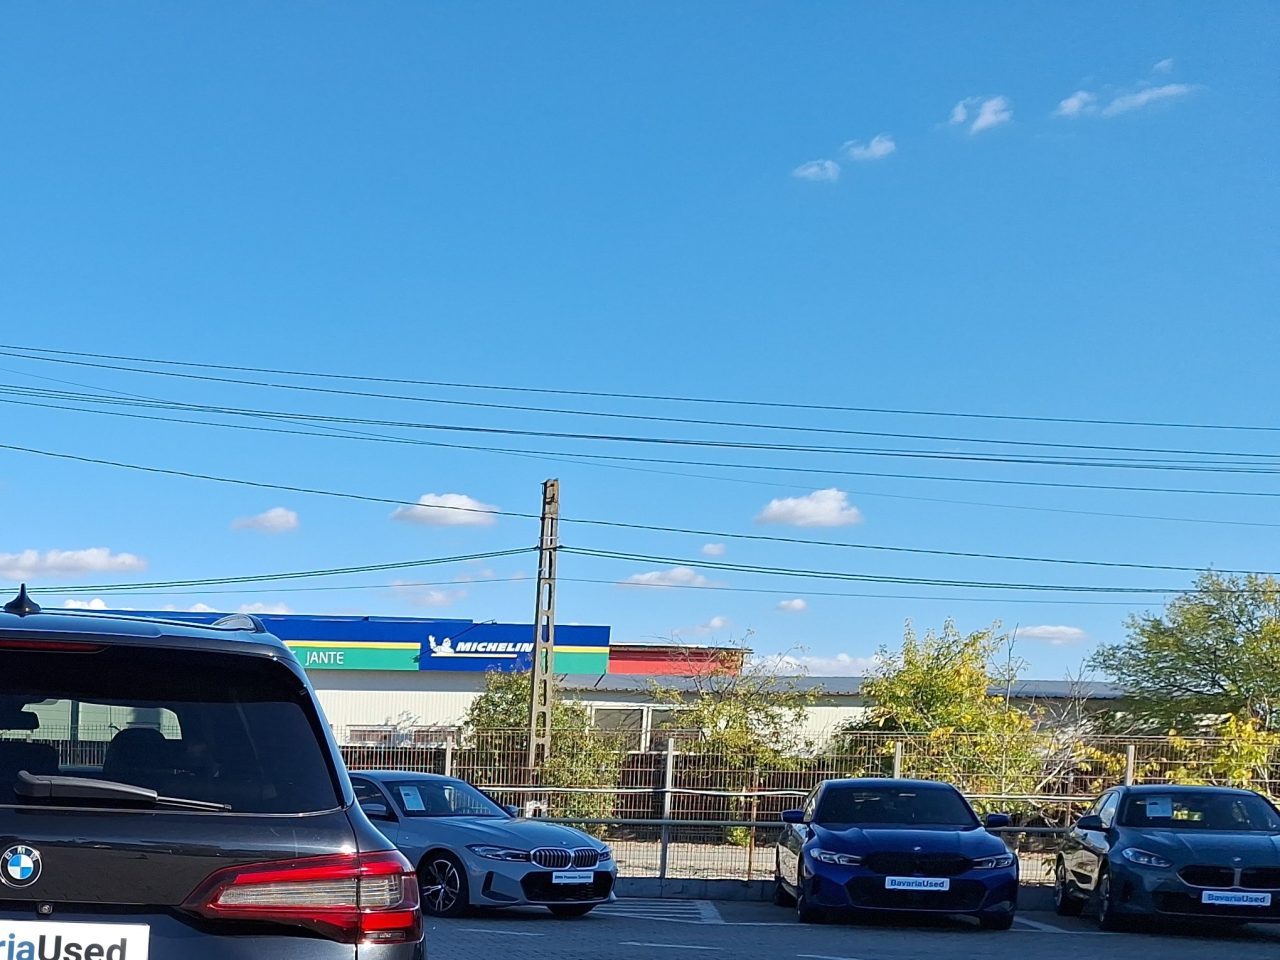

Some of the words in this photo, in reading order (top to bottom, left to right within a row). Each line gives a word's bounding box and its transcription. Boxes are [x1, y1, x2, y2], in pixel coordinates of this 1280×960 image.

[455, 641, 535, 653] MICHELIN
[305, 651, 345, 666] JANTE
[890, 879, 945, 888] BavariaUsed
[1207, 893, 1266, 903] BavariaUsed
